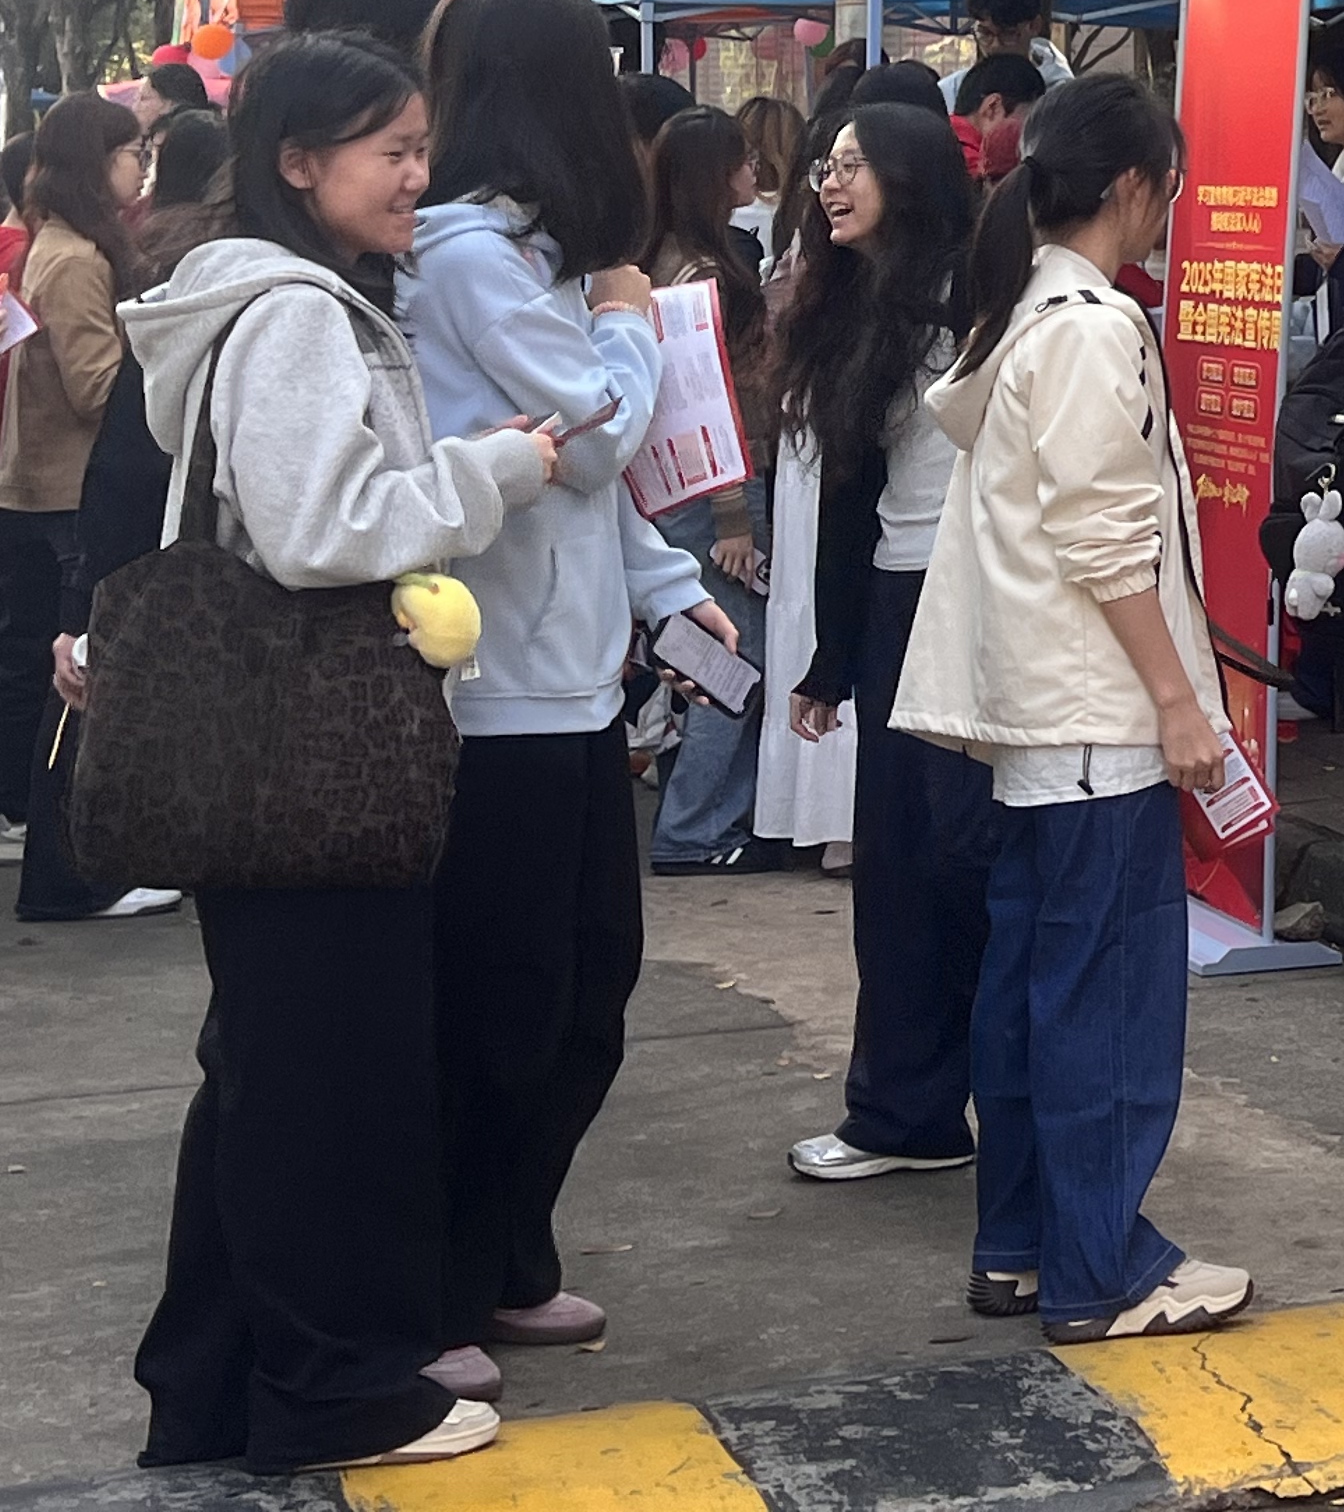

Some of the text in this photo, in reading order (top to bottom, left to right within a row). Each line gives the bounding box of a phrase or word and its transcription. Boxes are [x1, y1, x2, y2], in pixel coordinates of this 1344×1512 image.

[1180, 259, 1285, 305] 2025年国家宪法日
[1177, 299, 1282, 352] 暨全国宪法宣传周
